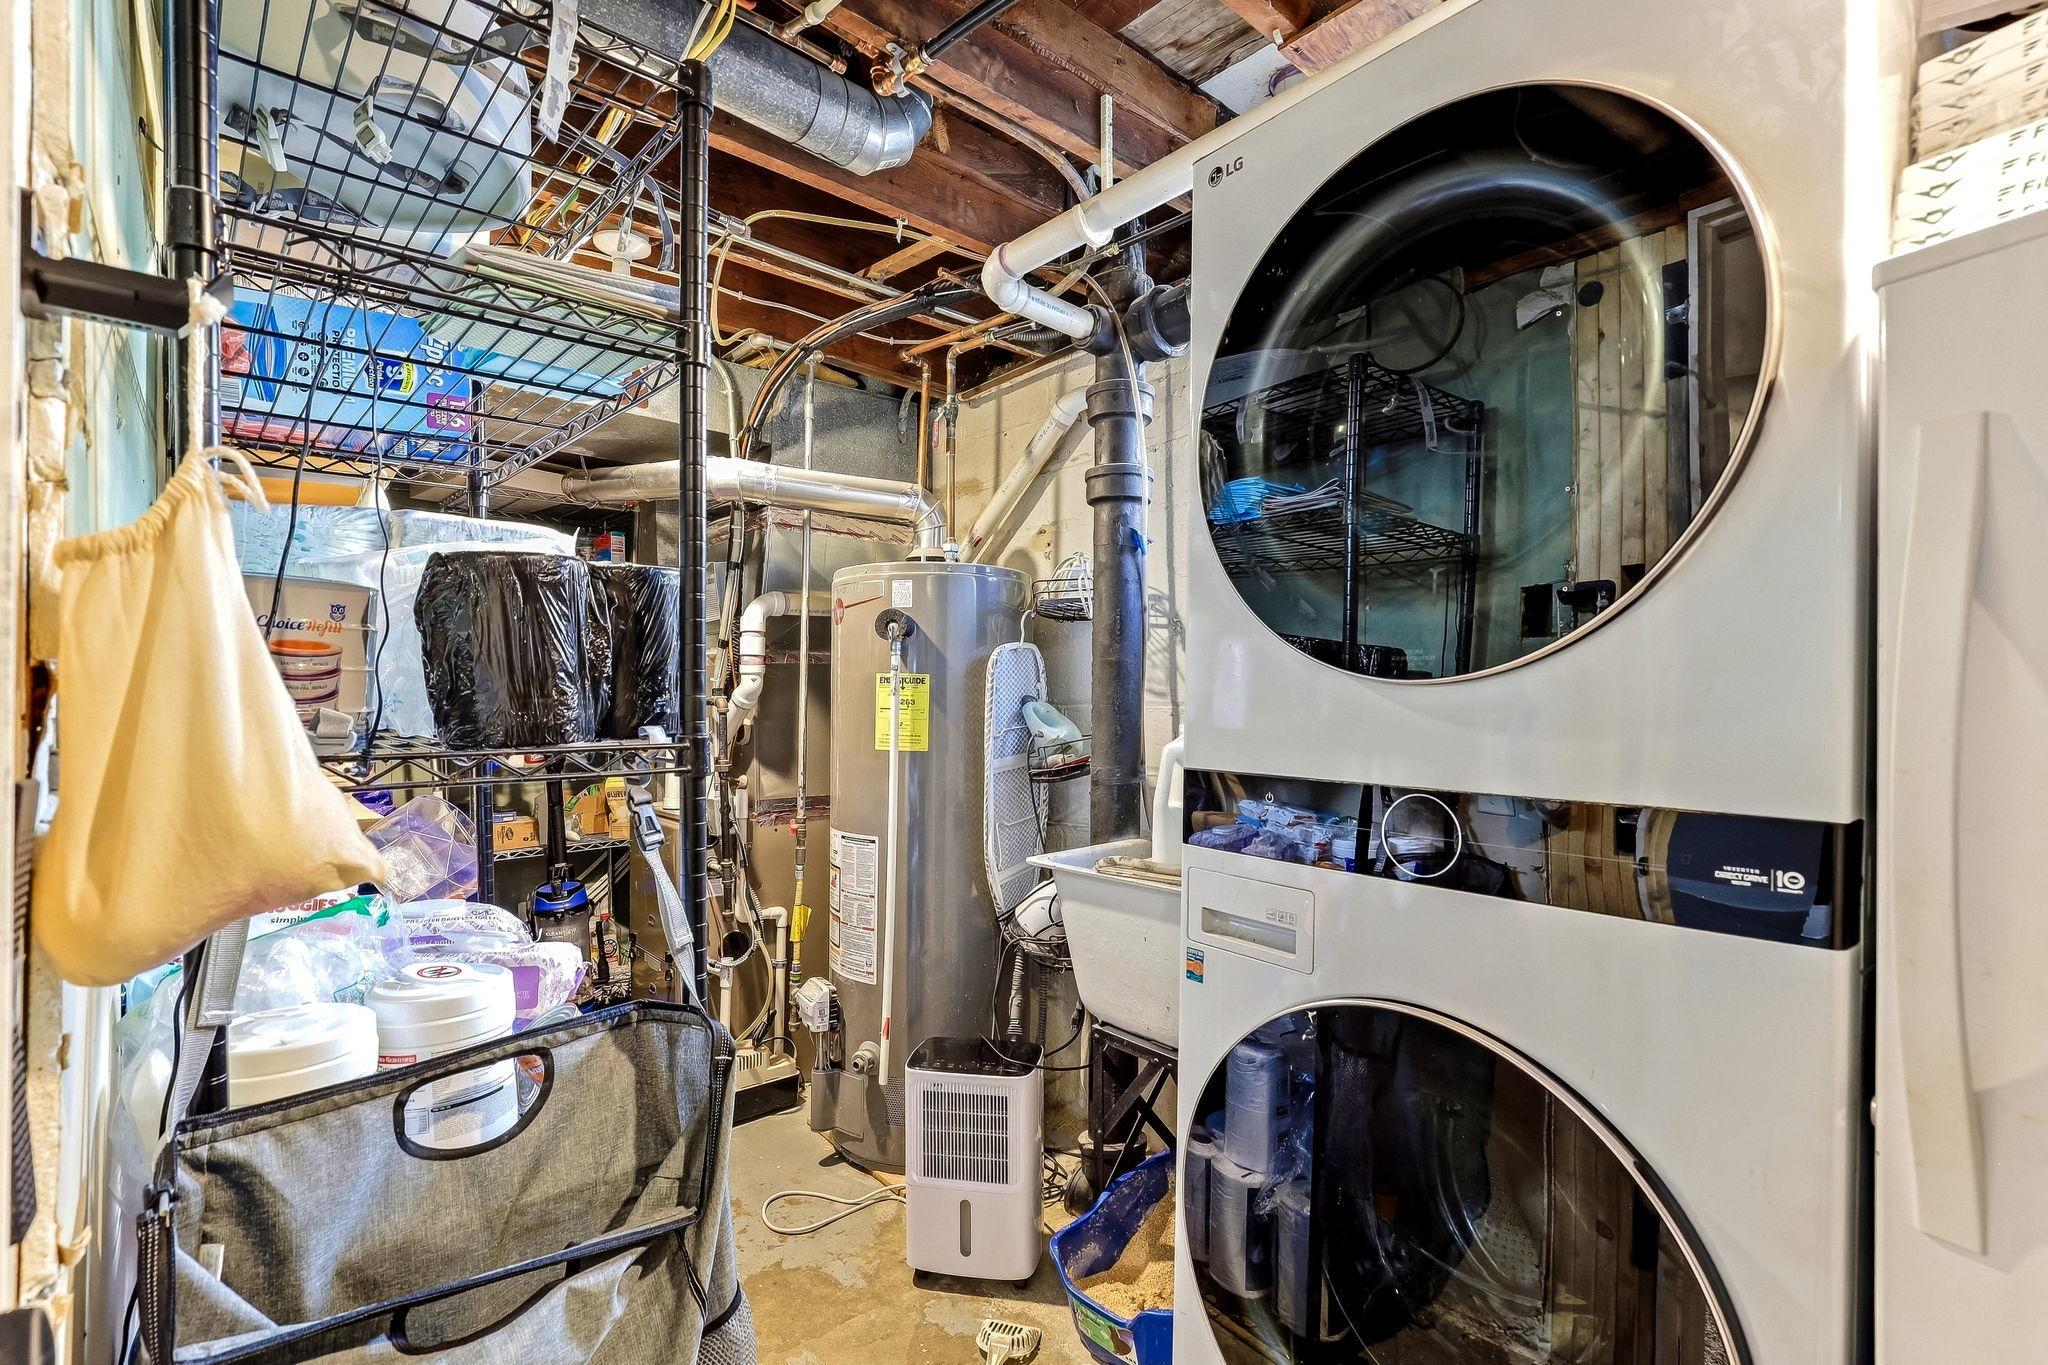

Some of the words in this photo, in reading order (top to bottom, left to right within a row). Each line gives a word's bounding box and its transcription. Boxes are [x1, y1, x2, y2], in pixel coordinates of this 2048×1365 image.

[1226, 156, 1244, 177] LG
[900, 698, 916, 706] 263
[1775, 870, 1806, 890] 10
